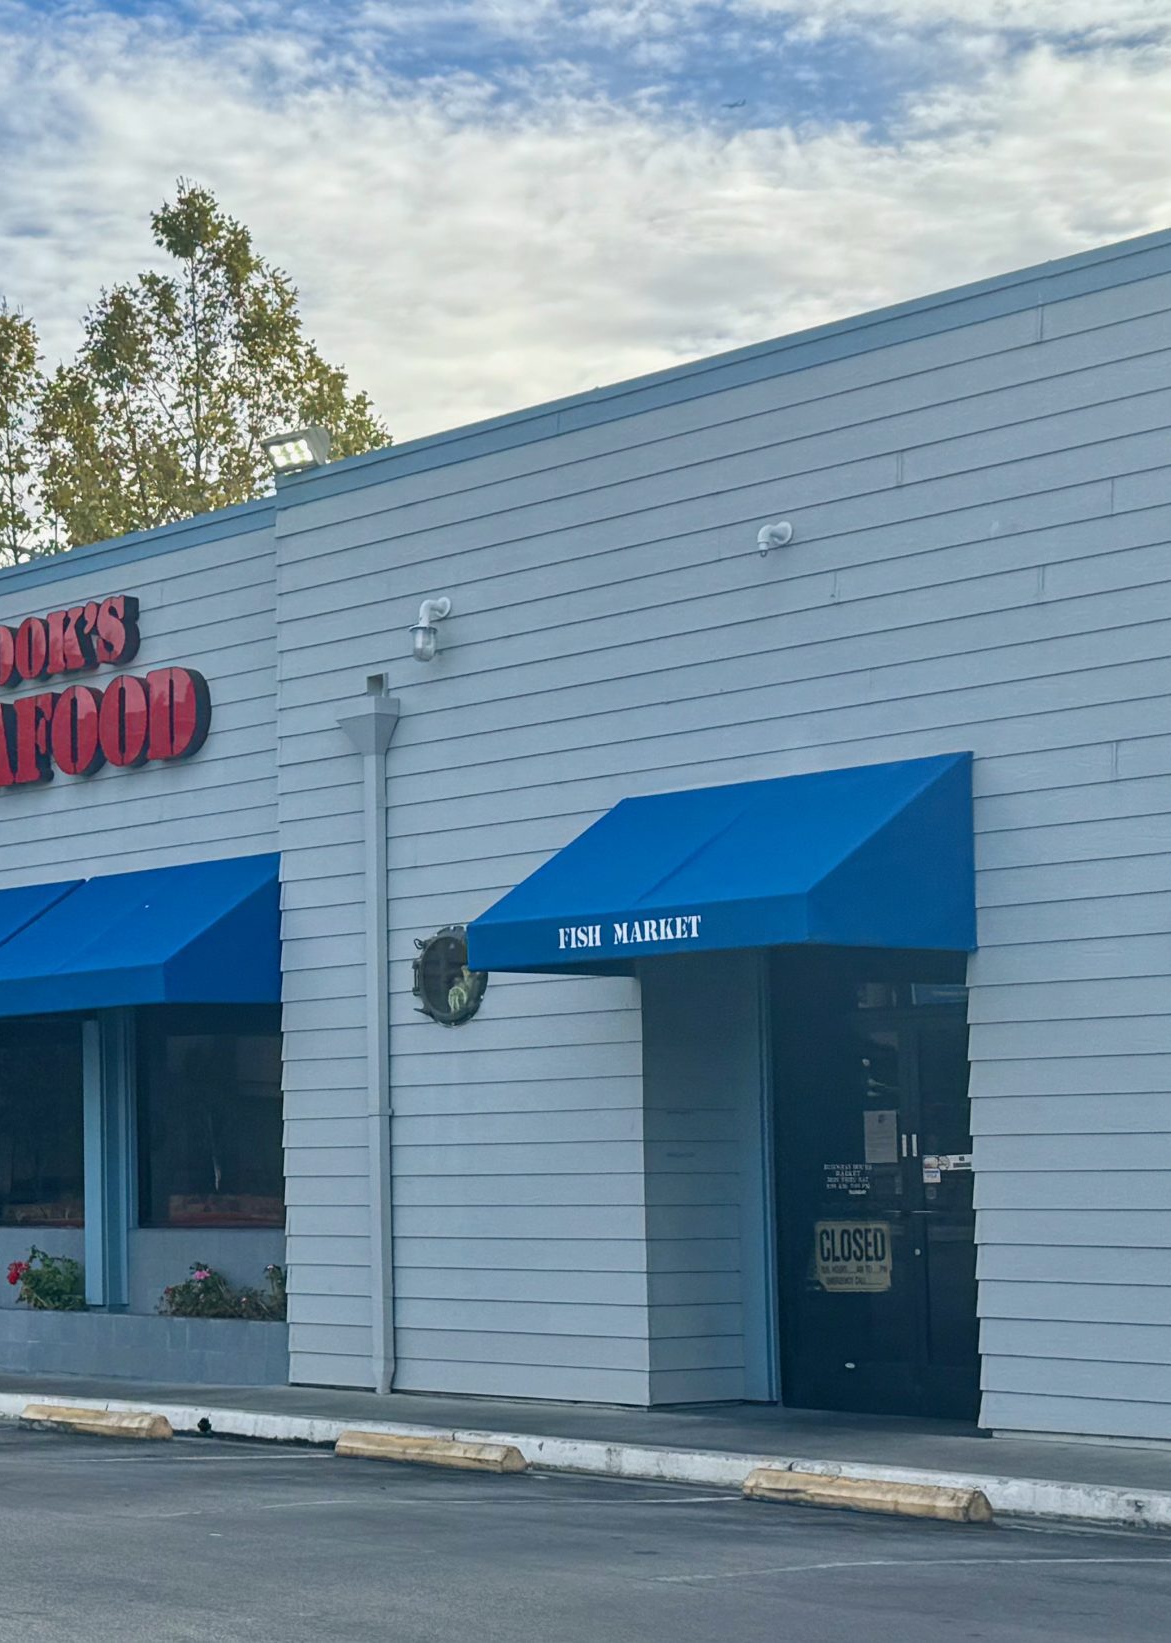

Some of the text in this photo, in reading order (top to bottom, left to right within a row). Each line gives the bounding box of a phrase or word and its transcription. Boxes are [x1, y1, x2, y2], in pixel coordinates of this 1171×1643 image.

[558, 915, 702, 949] FISH MARKET
[820, 1227, 886, 1262] CLOSED
